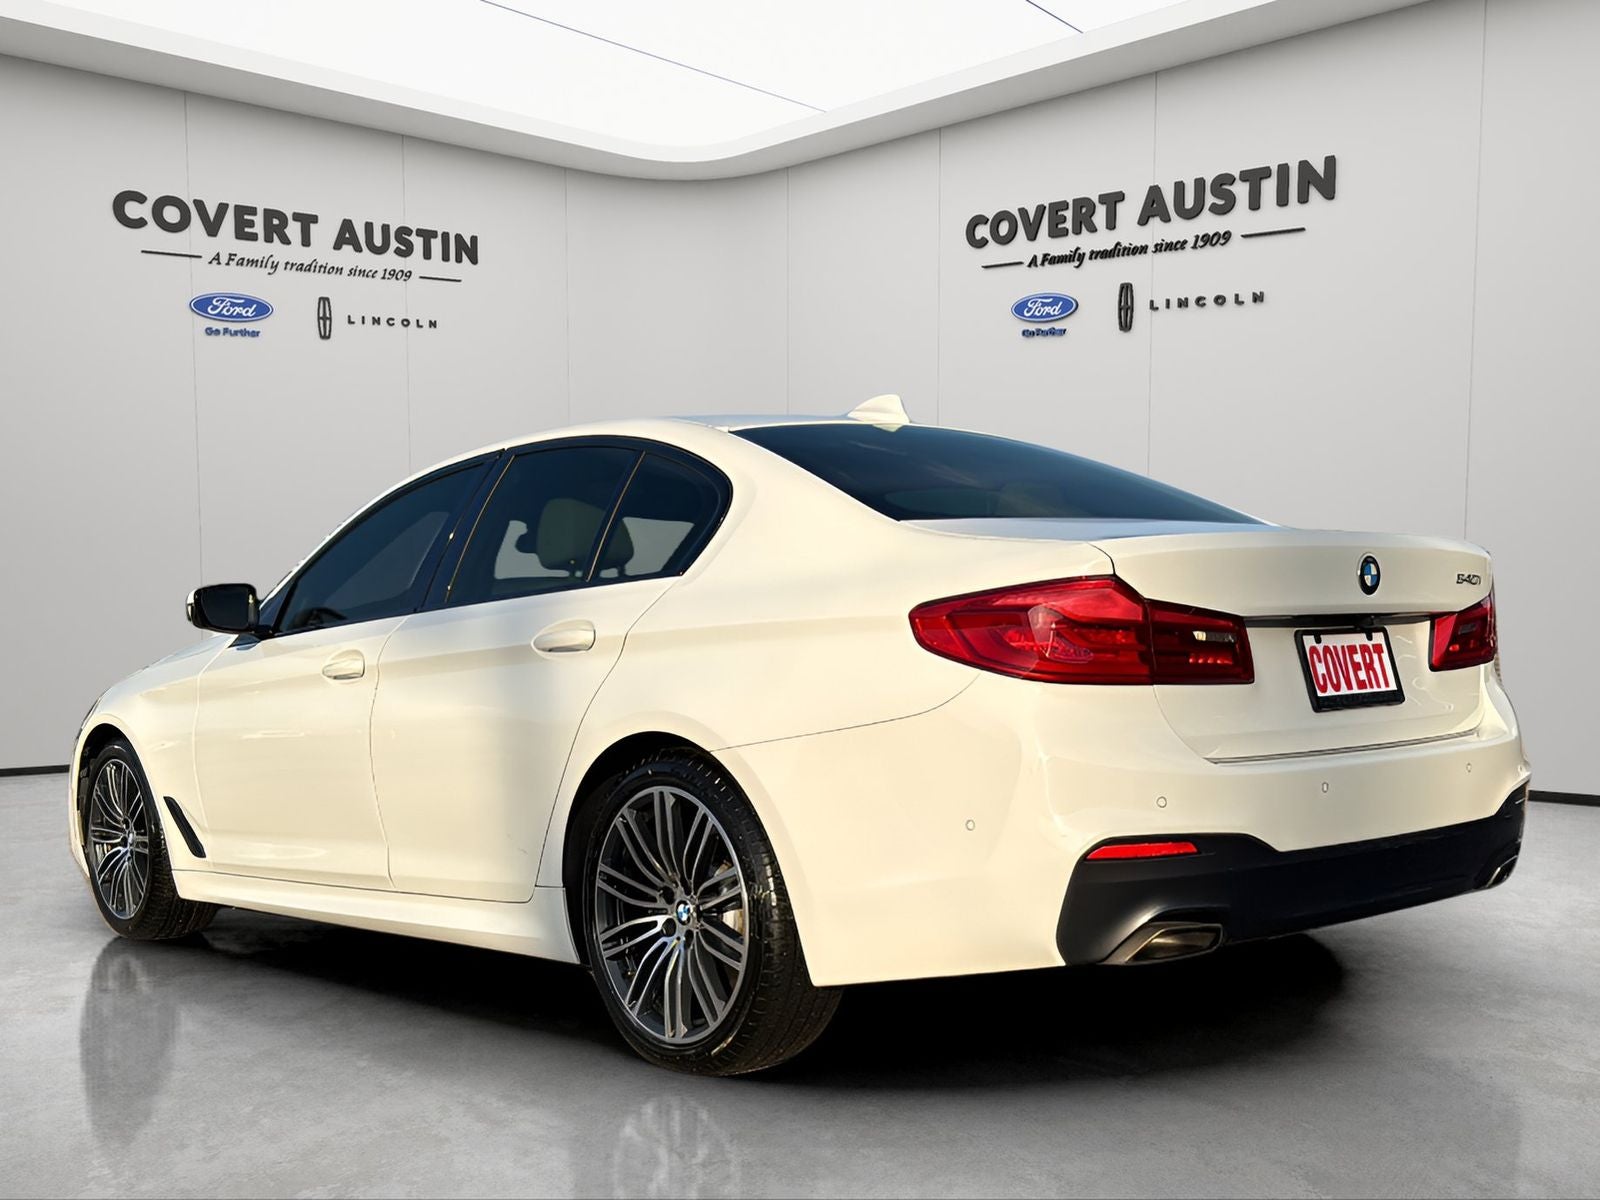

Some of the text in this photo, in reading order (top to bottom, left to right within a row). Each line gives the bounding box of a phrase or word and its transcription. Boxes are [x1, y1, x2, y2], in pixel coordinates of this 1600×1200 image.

[965, 154, 1337, 250] COVERT AUSTIN
[112, 189, 479, 266] COVERT AUSTIN
[1026, 230, 1233, 269] A Family tradition since 1909
[207, 251, 413, 282] A Family tradition since 1909
[207, 296, 257, 317] Ford
[1023, 298, 1063, 317] Ford
[1149, 291, 1265, 312] LINCOLN
[205, 326, 261, 338] Go Further
[347, 314, 438, 329] LINCOLN
[1308, 643, 1390, 694] COVERT
